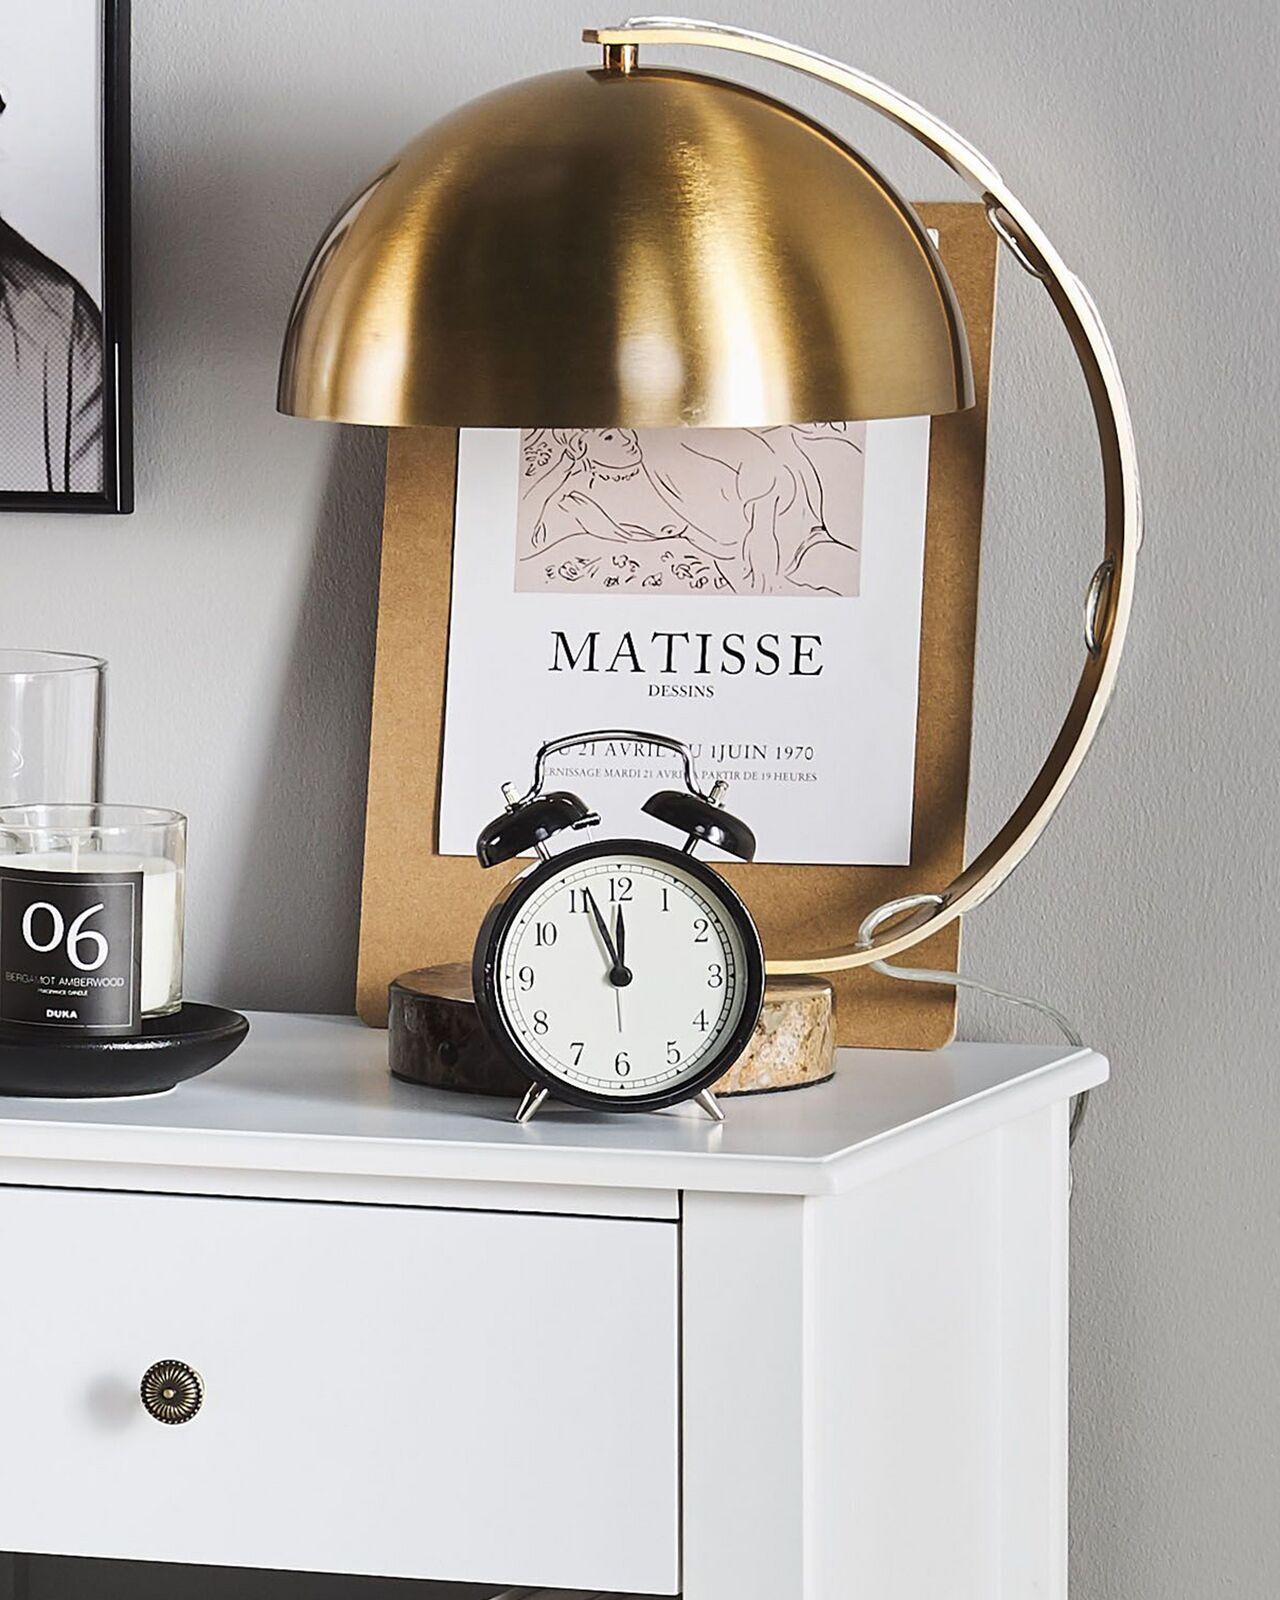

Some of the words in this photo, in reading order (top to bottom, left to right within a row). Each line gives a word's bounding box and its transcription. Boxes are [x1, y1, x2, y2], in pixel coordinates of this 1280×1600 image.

[548, 629, 824, 677] MATISSE
[648, 683, 715, 699] DESSINS
[578, 742, 596, 756] 21
[775, 745, 814, 761] 1970
[604, 768, 641, 779] MARDI
[701, 770, 741, 781] PARTIR
[743, 771, 759, 781] DE
[761, 771, 772, 781] 19
[774, 772, 818, 782] HEURES
[569, 884, 590, 913] 11
[609, 876, 633, 902] 12
[661, 887, 669, 912] 1
[22, 901, 109, 971] 06
[535, 921, 557, 946] 10
[693, 918, 709, 943] 2
[58, 976, 124, 988] AMBERWOOD
[519, 966, 535, 991] 9
[707, 963, 723, 988] 3
[46, 1009, 78, 1019] DUKA
[533, 1009, 549, 1035] 8
[692, 1008, 709, 1032] 4
[569, 1042, 585, 1066] 7
[614, 1052, 631, 1077] 6
[666, 1040, 681, 1065] 5
